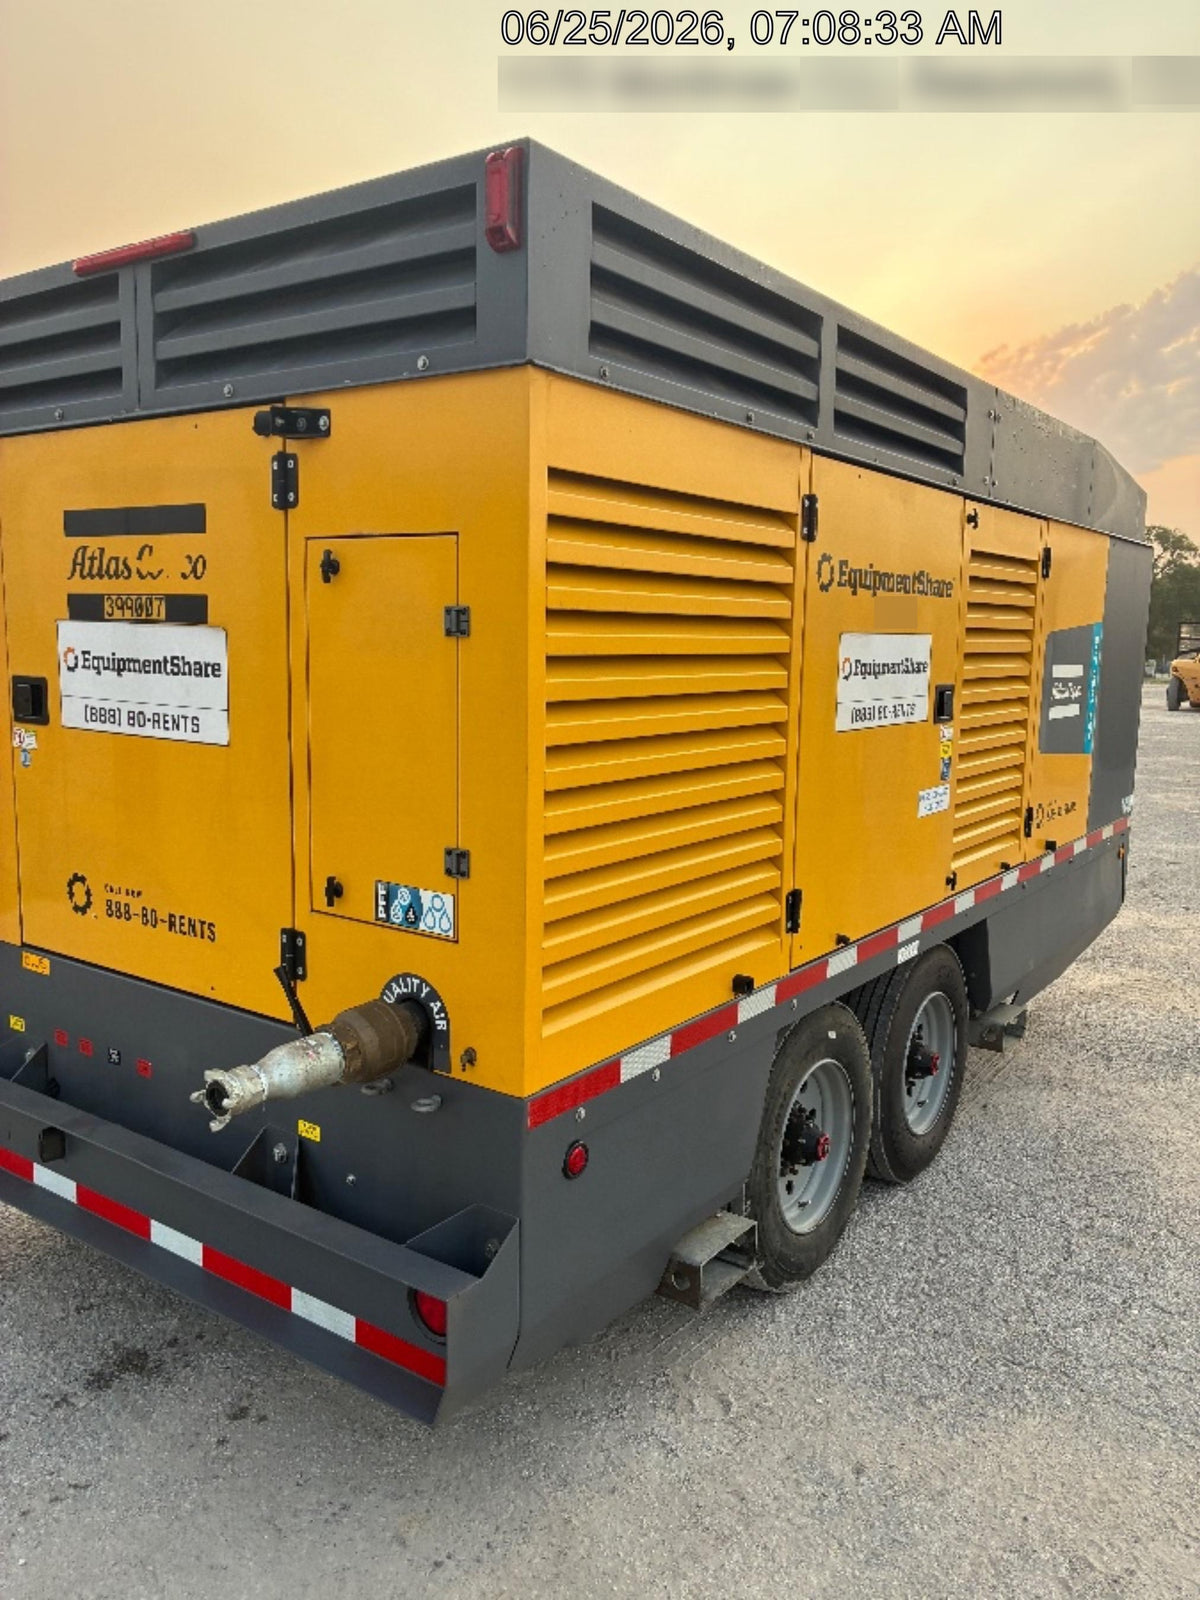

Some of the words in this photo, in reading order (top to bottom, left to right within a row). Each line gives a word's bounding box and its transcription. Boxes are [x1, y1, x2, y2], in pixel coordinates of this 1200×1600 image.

[67, 545, 132, 580] Atlas
[837, 560, 953, 598] EquipmentShare
[81, 650, 222, 678] EquipmentShare
[84, 704, 121, 727] (888)
[127, 711, 200, 734] 80-RENTS
[105, 899, 216, 943] 888-80-RENTS
[383, 977, 431, 1004] UALITY
[429, 1001, 447, 1031] AIR
